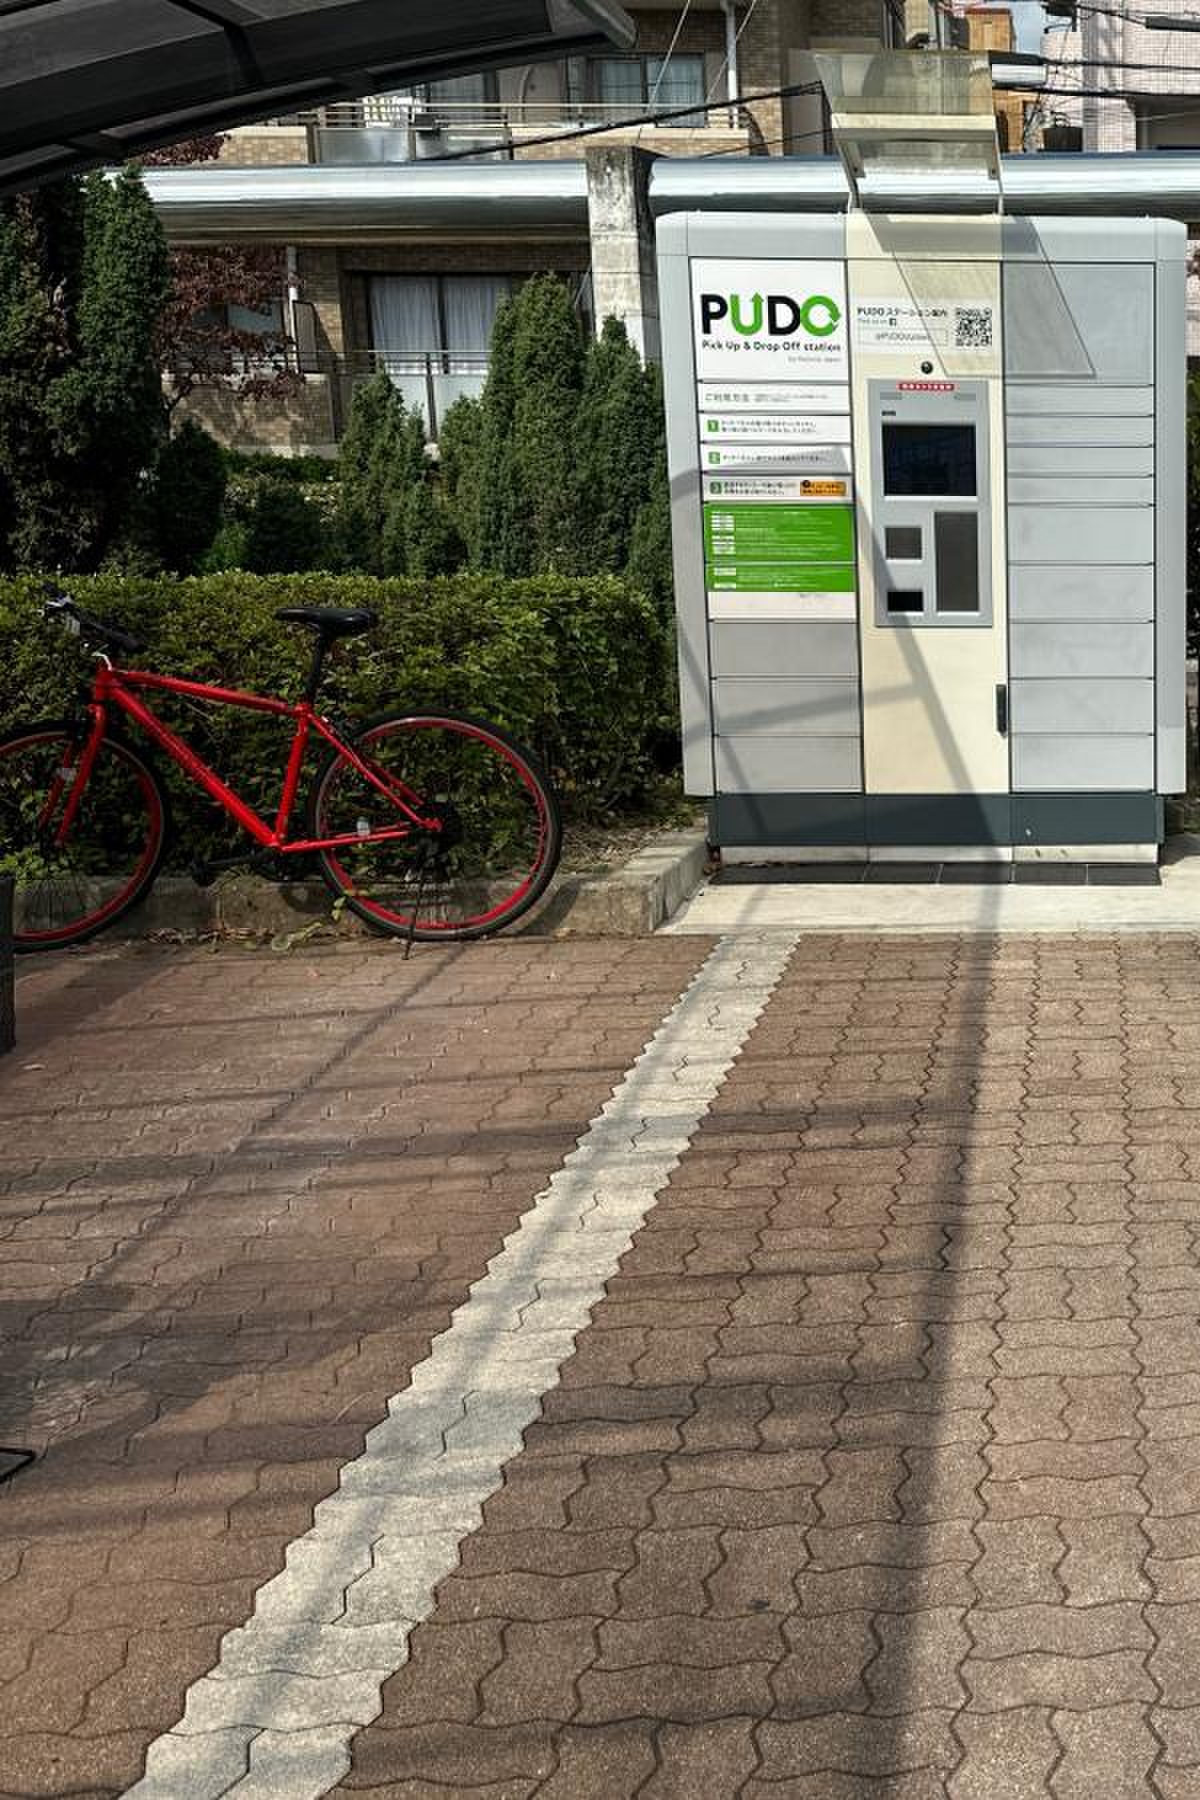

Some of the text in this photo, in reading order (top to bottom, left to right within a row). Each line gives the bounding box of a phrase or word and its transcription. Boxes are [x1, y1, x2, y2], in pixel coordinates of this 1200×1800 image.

[700, 292, 841, 336] PUDO
[857, 307, 884, 317] PUDO
[702, 340, 841, 352] Pick Up & Drop Off station
